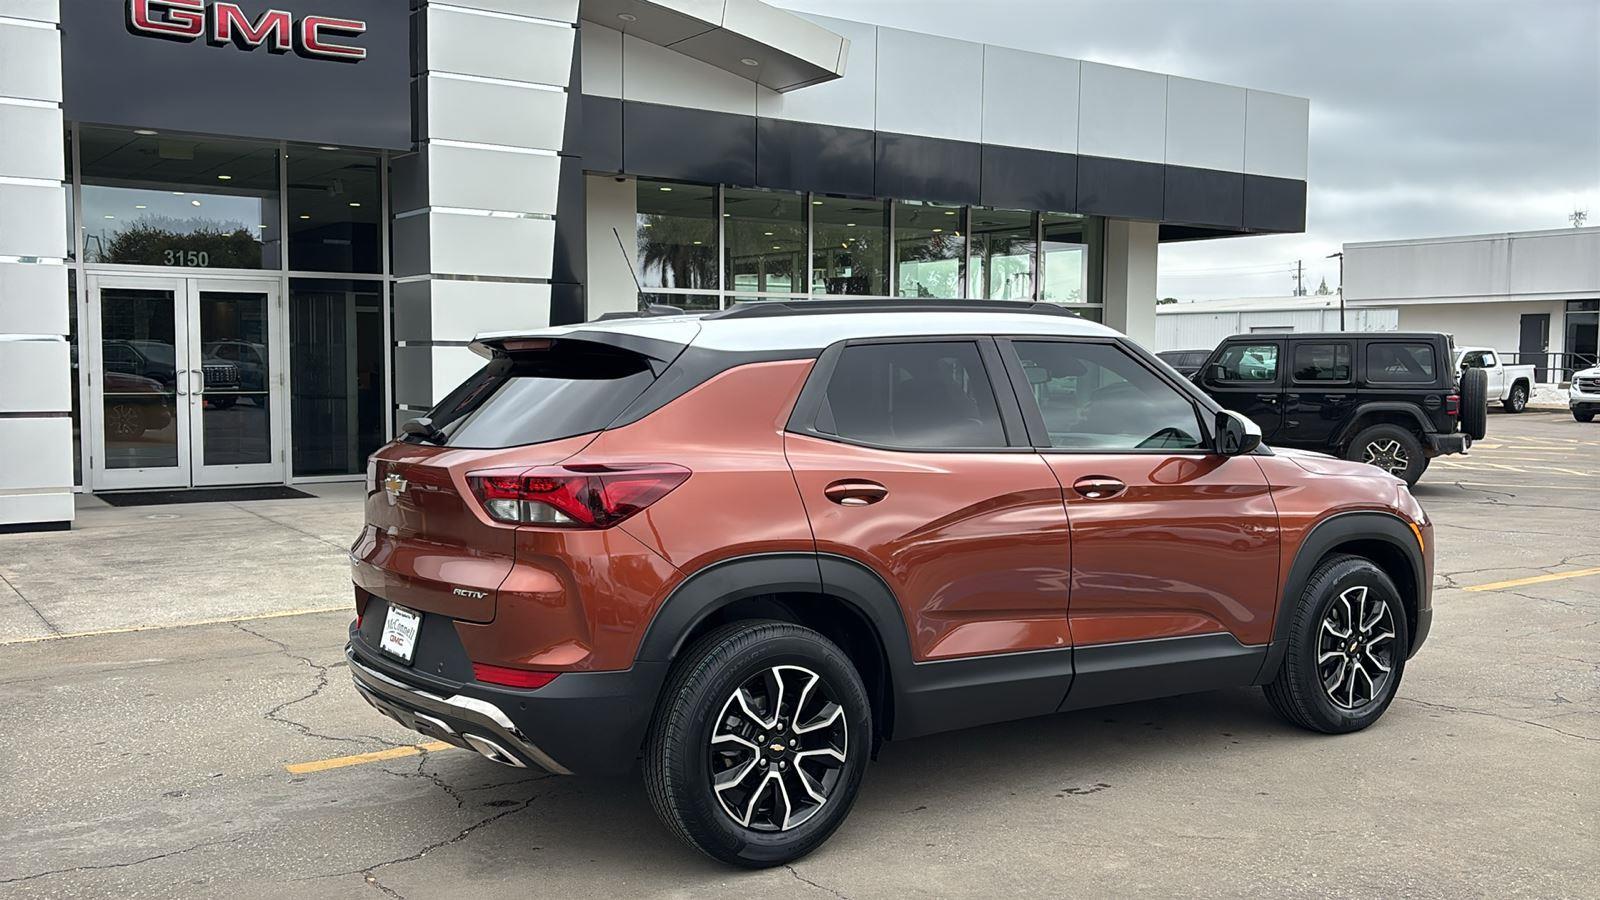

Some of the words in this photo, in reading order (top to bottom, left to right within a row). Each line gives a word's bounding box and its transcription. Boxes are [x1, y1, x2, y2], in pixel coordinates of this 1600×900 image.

[128, 0, 367, 60] GMC
[163, 249, 209, 268] 3150
[453, 588, 488, 599] ACTIV
[389, 634, 404, 647] GMC
